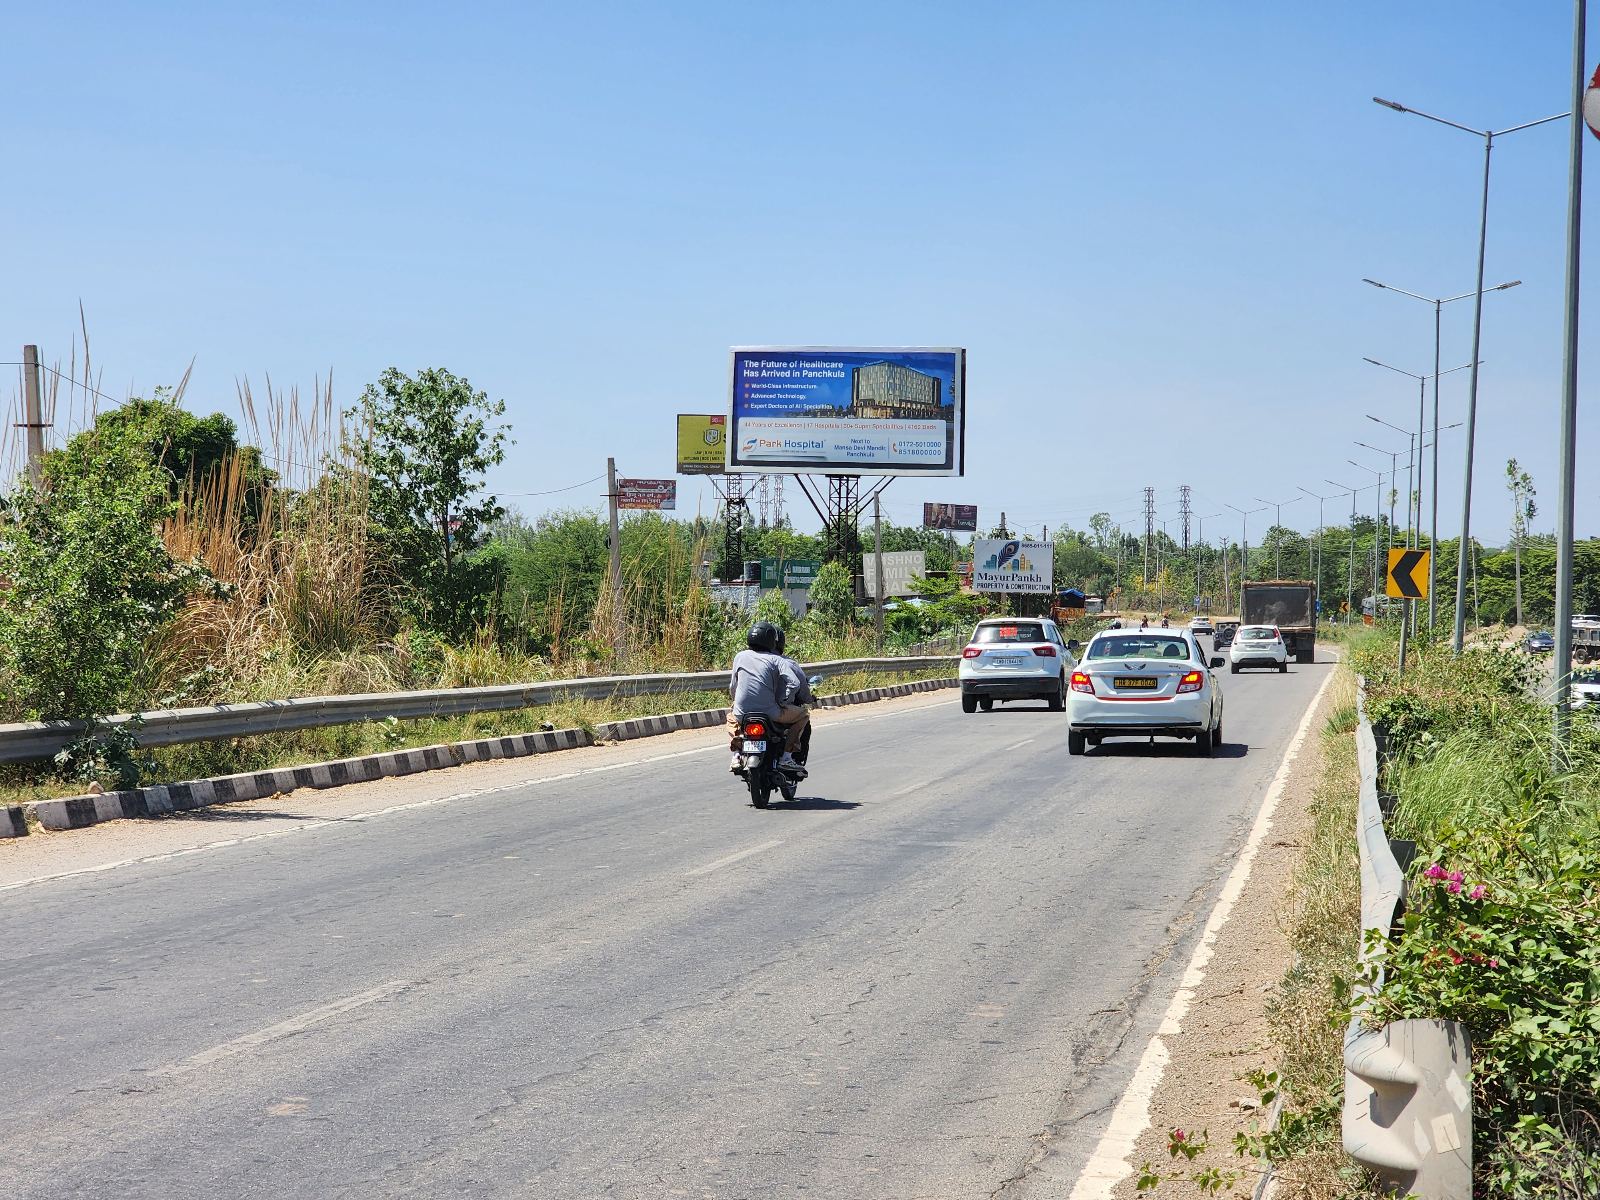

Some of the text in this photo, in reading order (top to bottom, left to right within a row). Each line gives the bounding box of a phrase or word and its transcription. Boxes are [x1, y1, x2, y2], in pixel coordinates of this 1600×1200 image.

[744, 360, 844, 369] The Future of Healthcare
[743, 369, 845, 378] Has Arrived in Panchkula
[759, 439, 824, 451] Park Hospital
[976, 582, 1004, 590] PROPERTY
[1010, 583, 1051, 591] CONSTRUCTION
